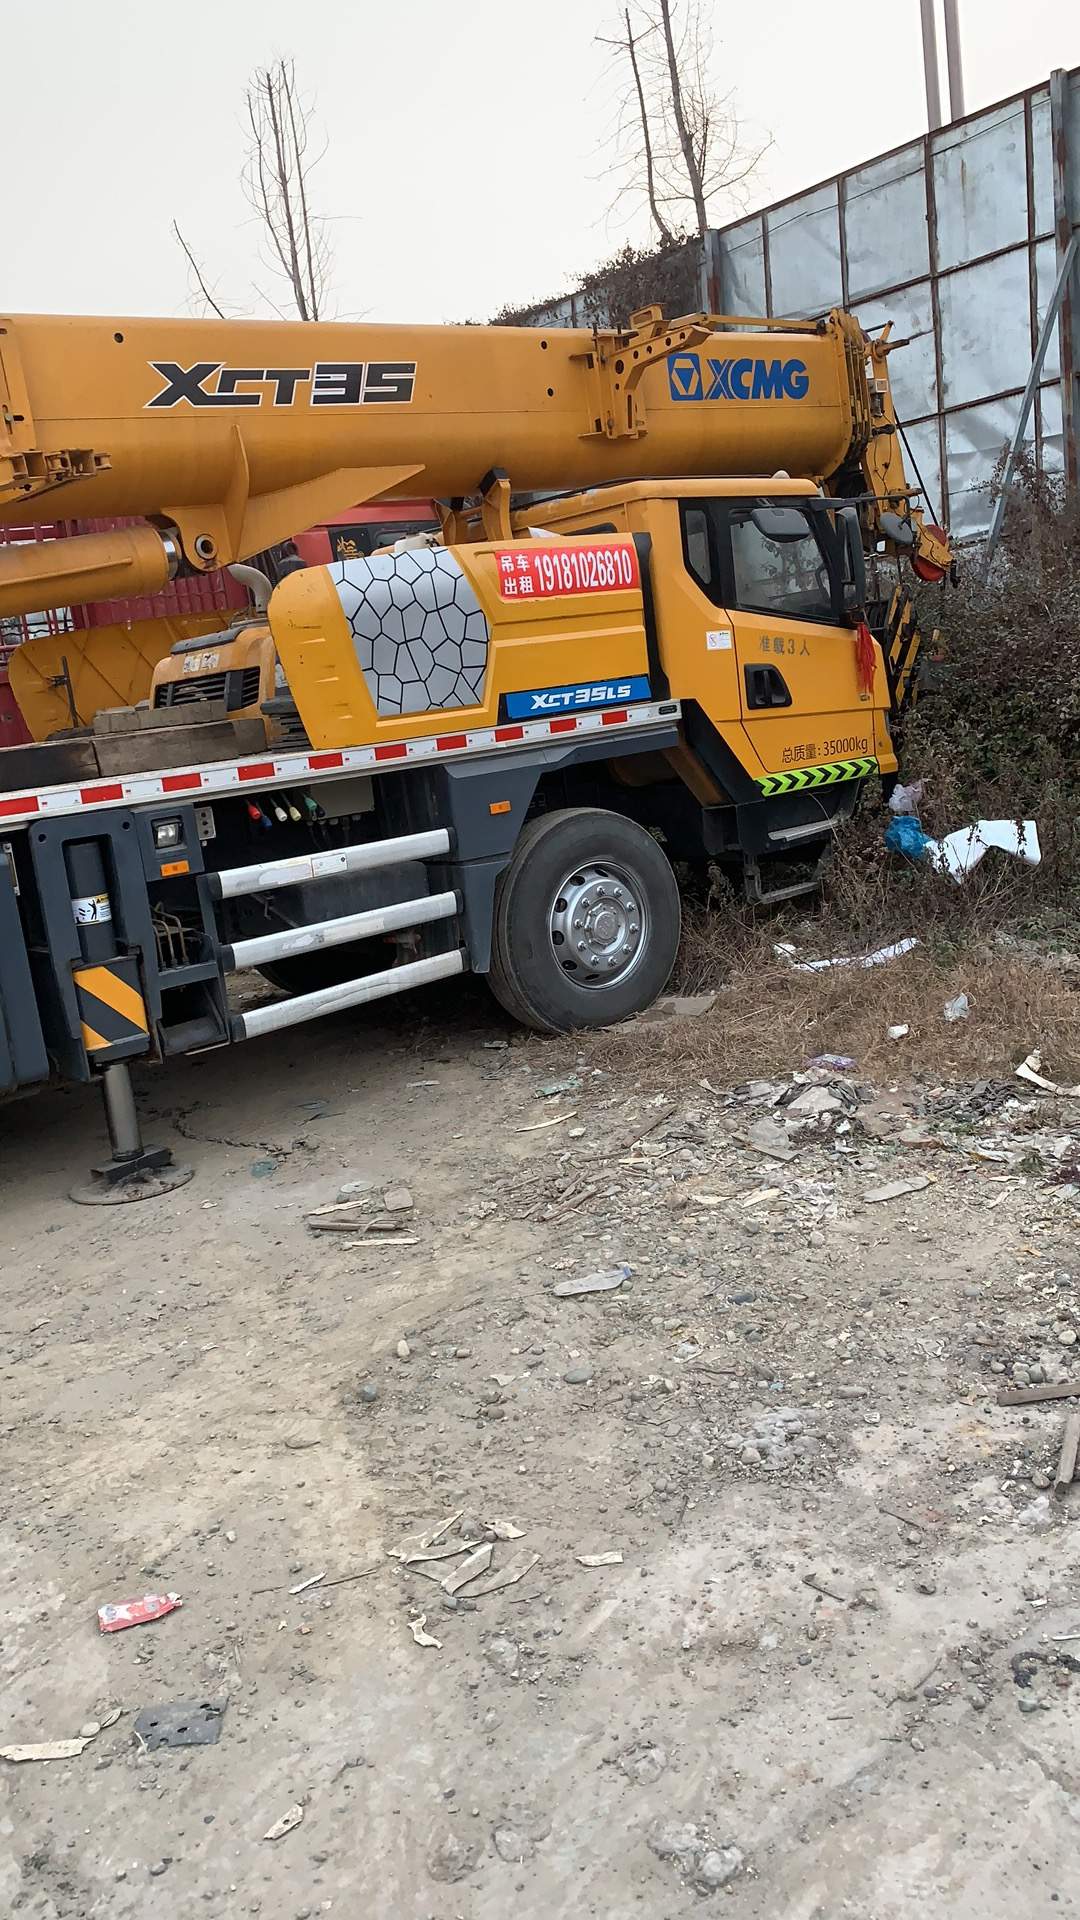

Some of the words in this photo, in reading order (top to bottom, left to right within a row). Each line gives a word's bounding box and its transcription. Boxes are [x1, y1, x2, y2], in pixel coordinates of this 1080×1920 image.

[142, 360, 417, 408] XCT35
[704, 357, 810, 400] XCMG
[500, 554, 530, 573] 吊车
[534, 549, 632, 592] 19181026810
[504, 575, 534, 595] 出租
[530, 684, 632, 710] XCT35LS
